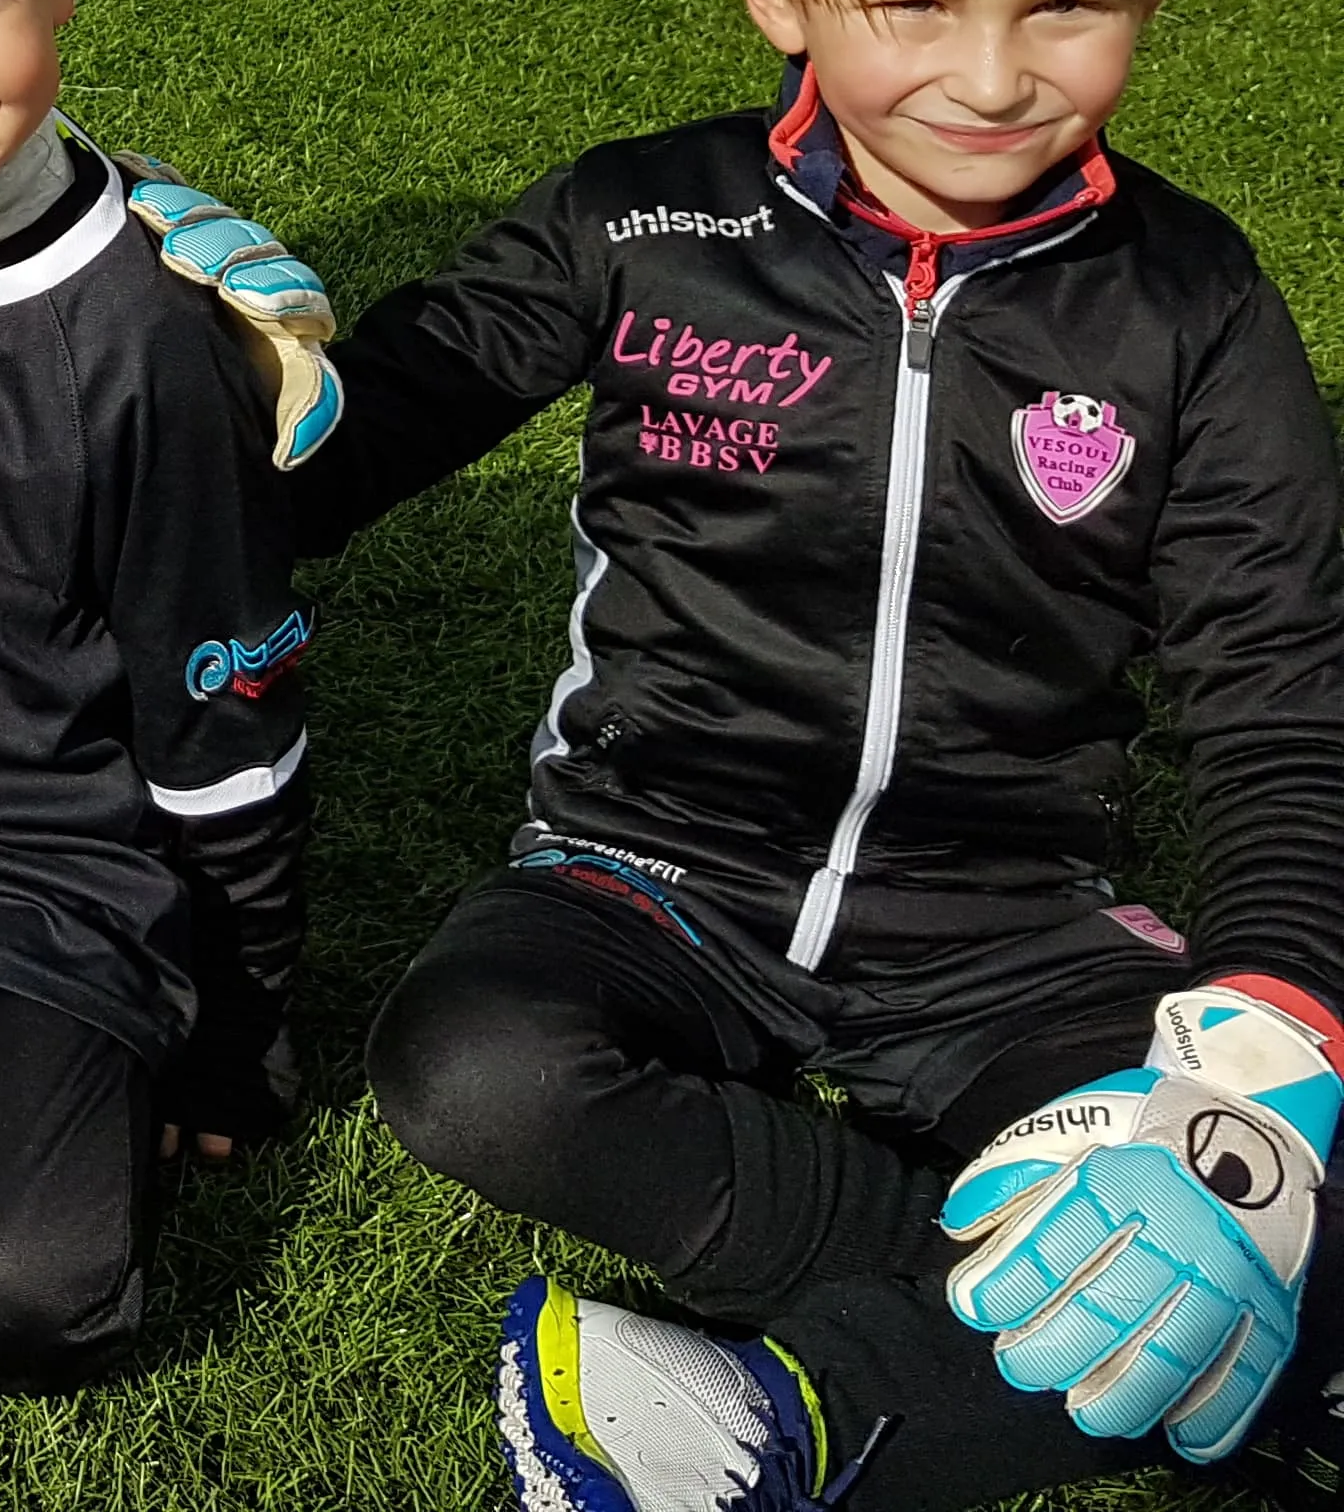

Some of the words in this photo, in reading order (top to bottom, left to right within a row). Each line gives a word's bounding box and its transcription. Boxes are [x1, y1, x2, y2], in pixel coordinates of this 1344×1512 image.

[606, 205, 775, 242] uhlsport
[613, 309, 833, 408] Liberty
[667, 372, 774, 405] GYM
[640, 404, 780, 449] LAVAGE
[1028, 435, 1112, 464] VESOUL
[1038, 456, 1098, 478] Racing
[1047, 476, 1083, 492] Club
[1166, 1001, 1203, 1071] uhlsport
